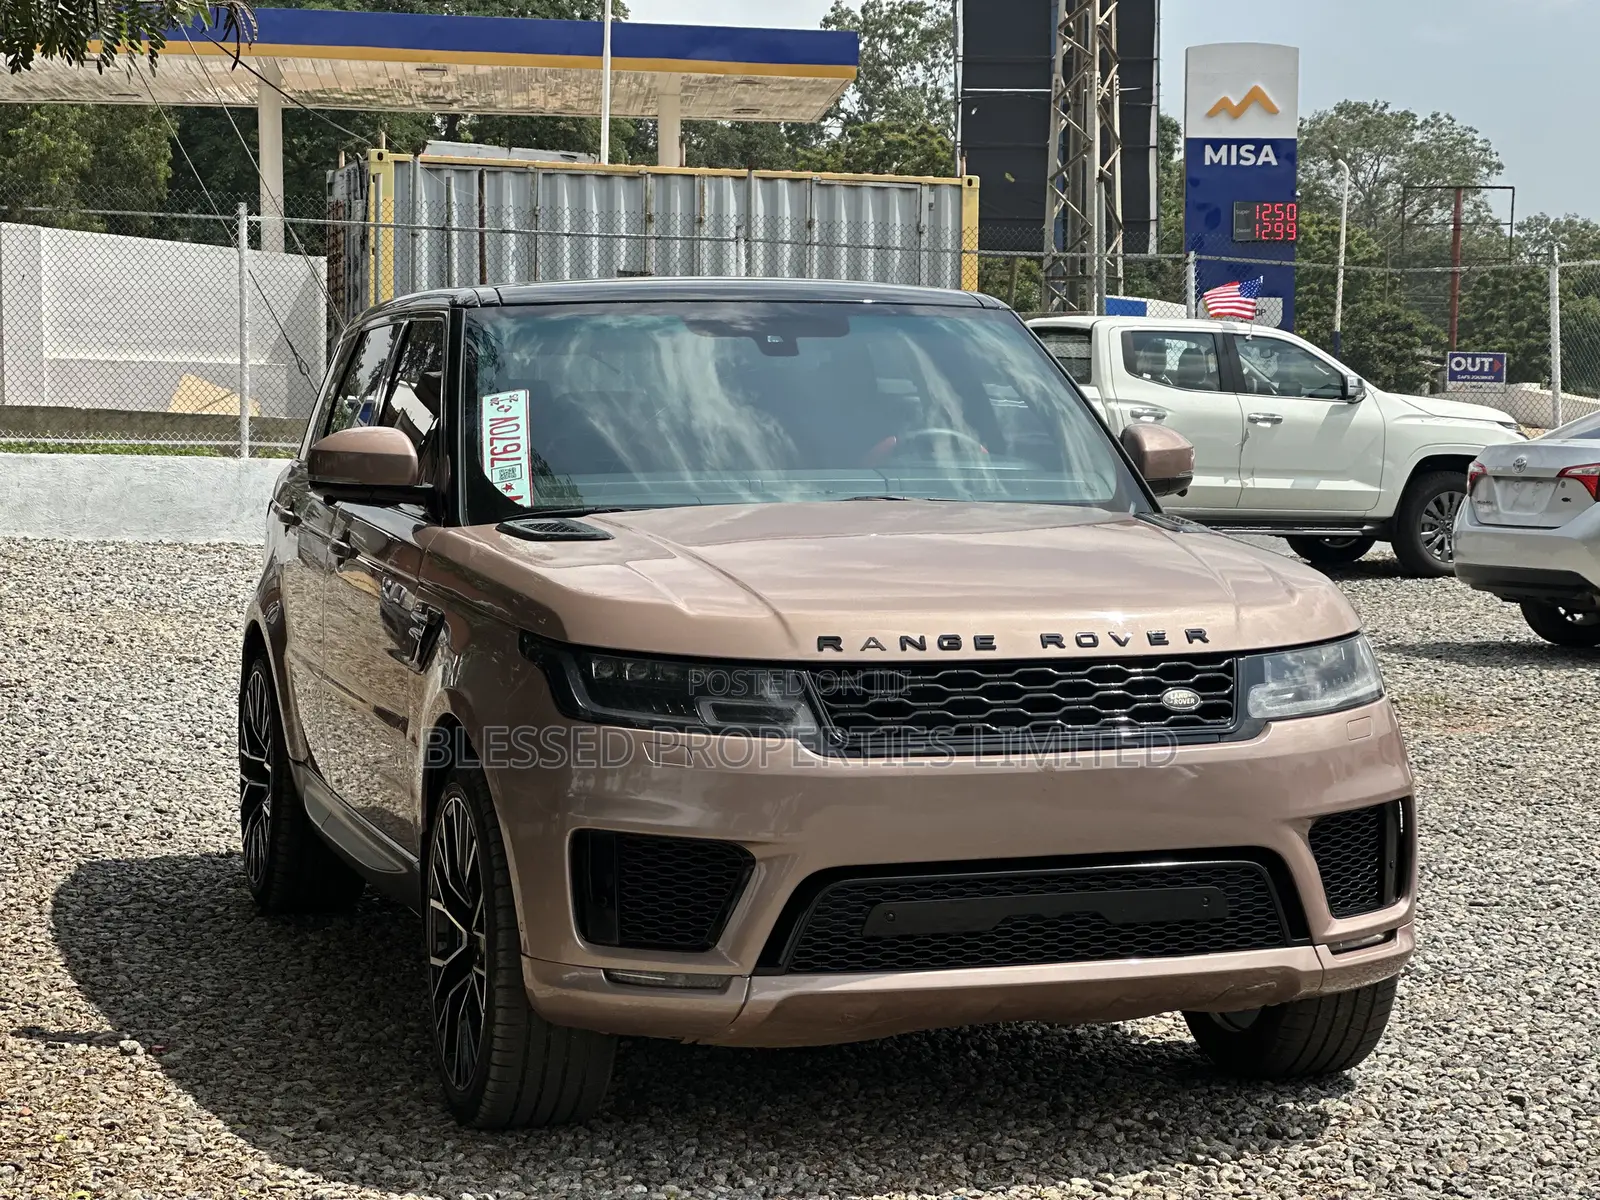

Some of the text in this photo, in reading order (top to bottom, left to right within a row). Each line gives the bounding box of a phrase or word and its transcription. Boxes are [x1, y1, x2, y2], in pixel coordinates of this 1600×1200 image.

[1204, 144, 1279, 167] MISA
[1255, 203, 1297, 221] 12.50
[1255, 222, 1297, 240] 12.99
[1450, 356, 1494, 372] OUT
[816, 627, 1211, 653] RANGE ROVER
[1173, 697, 1196, 705] ROVER
